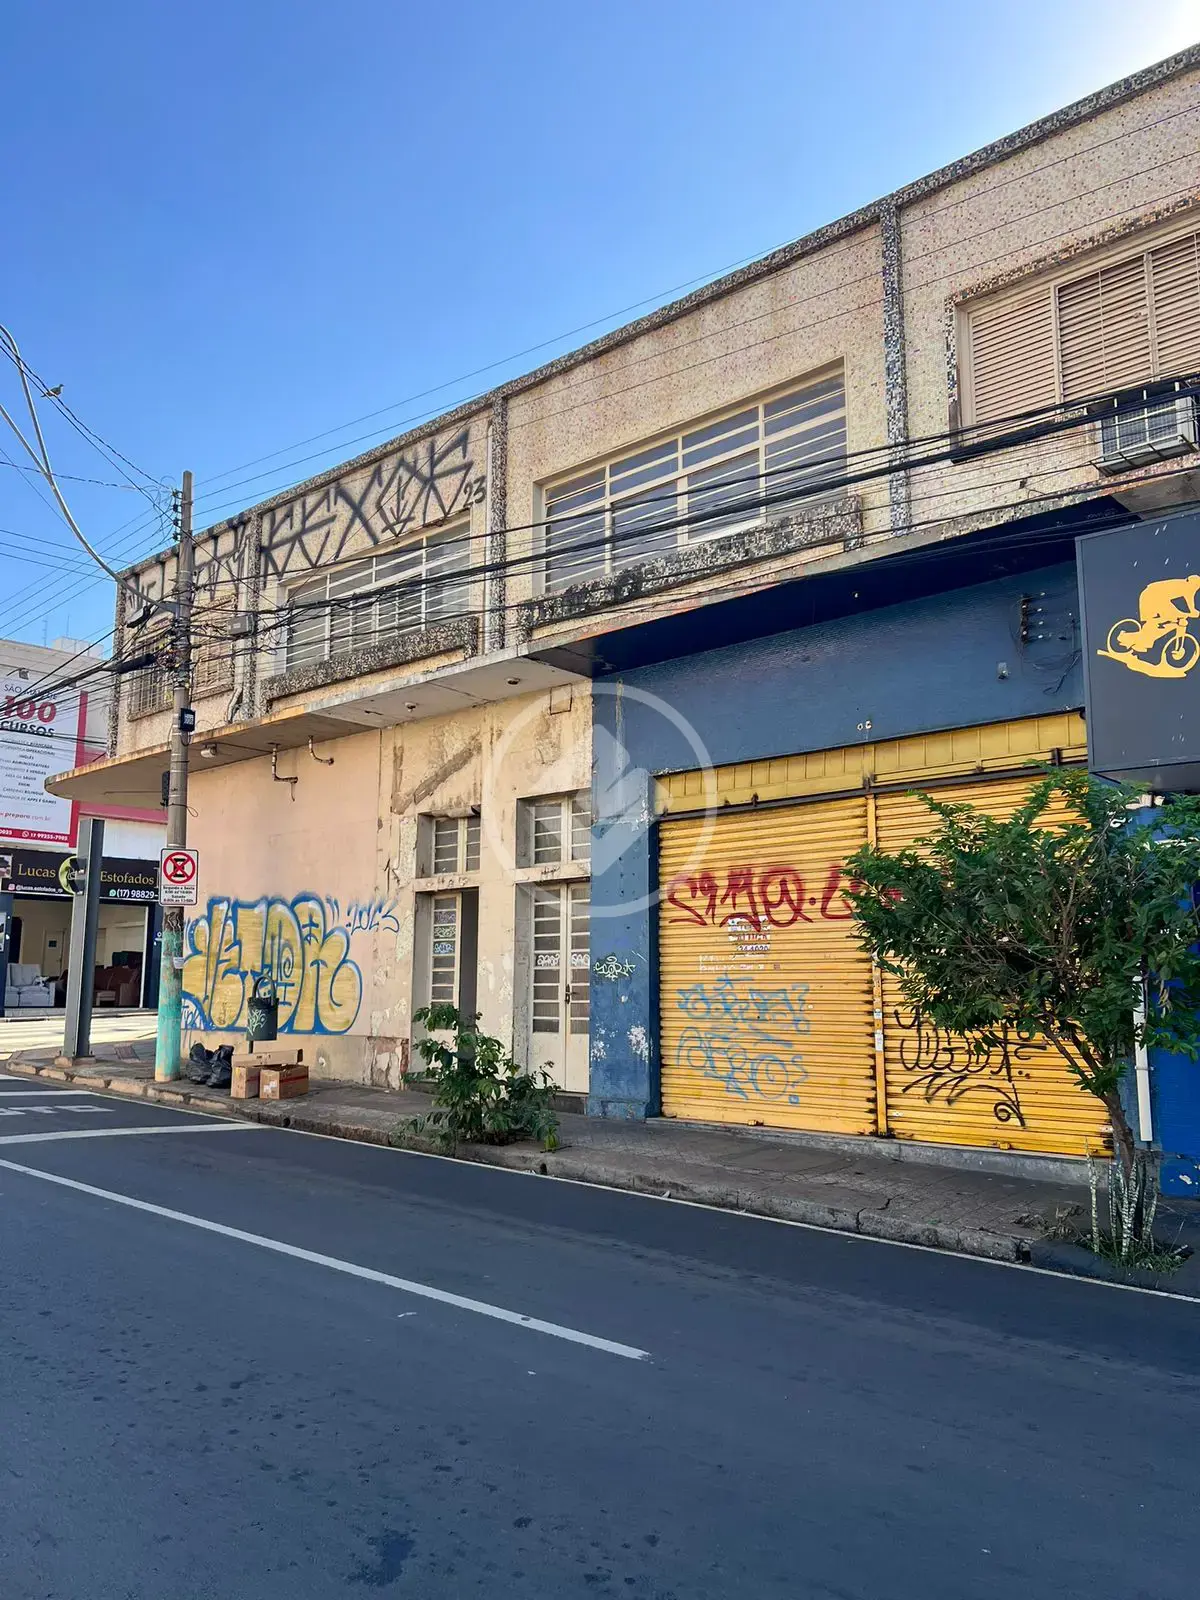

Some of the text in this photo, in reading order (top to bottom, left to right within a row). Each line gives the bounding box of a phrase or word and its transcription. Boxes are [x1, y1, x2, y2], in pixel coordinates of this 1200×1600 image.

[5, 695, 57, 723] 100
[1, 720, 55, 737] CURSOS
[18, 863, 155, 885] Lucas Estofados
[117, 888, 130, 898] (17)
